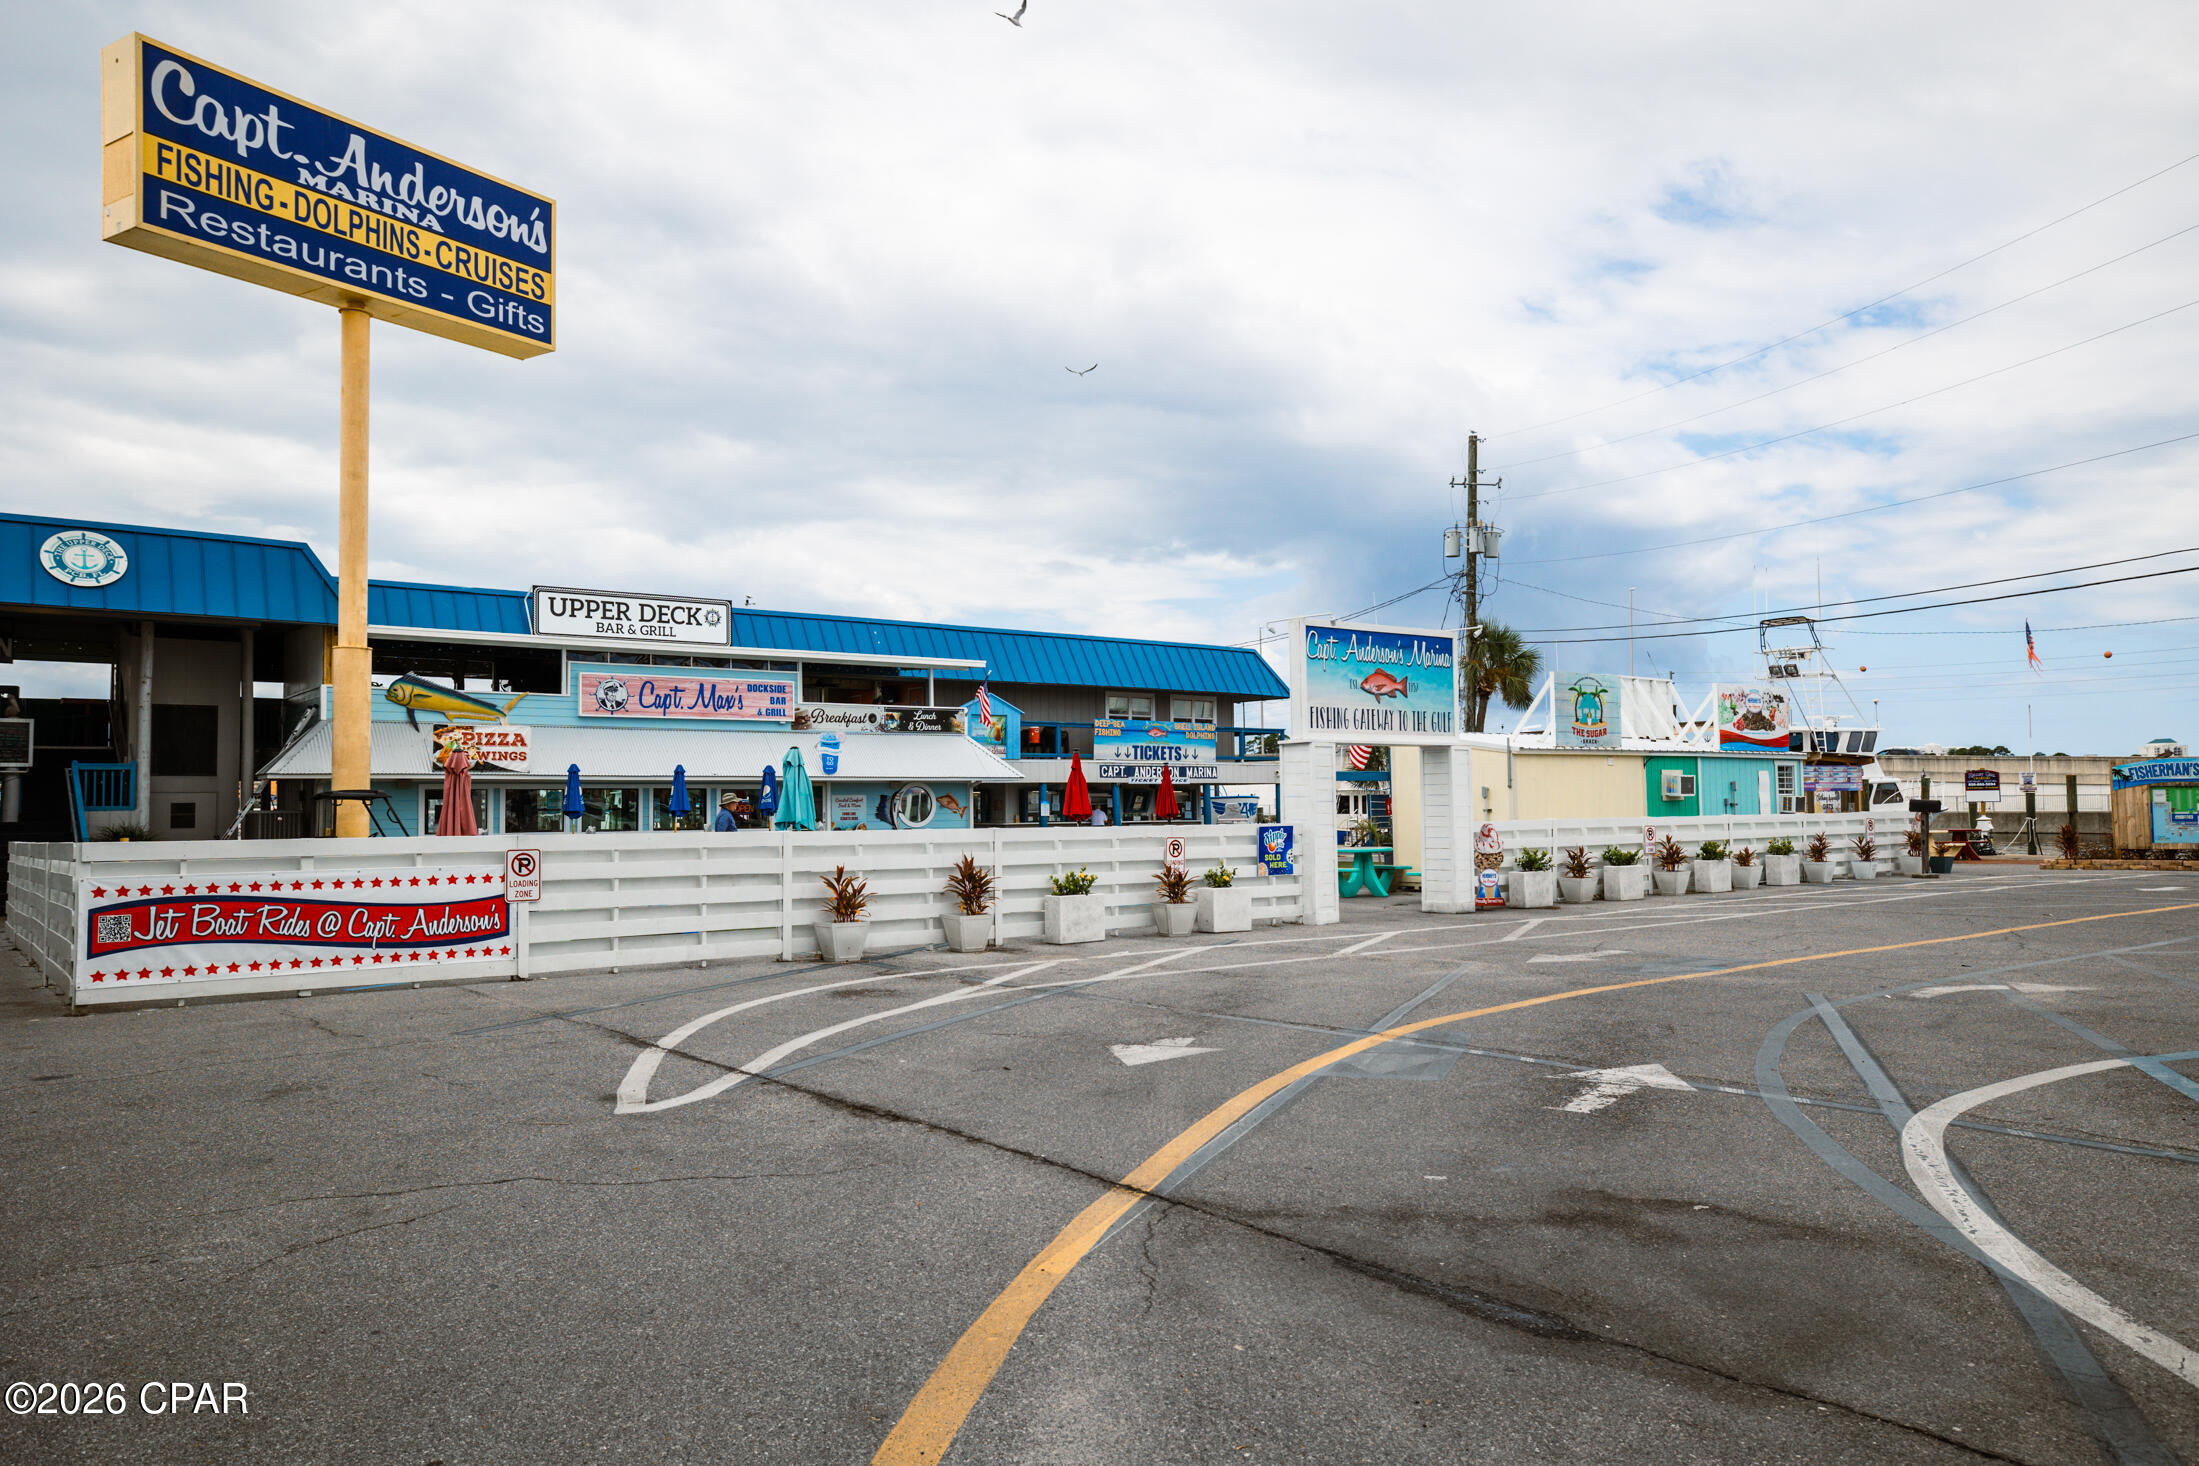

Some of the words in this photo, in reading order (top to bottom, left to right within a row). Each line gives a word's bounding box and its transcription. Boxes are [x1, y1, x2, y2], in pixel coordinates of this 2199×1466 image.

[151, 59, 309, 164] Capt.
[315, 133, 548, 254] Anderson's
[297, 167, 445, 233] MARINA
[160, 189, 428, 299] Restaurants
[467, 290, 545, 335] Gifts
[66, 538, 98, 547] UPPER
[97, 544, 114, 560] DECK
[548, 596, 632, 622] UPPER
[638, 603, 703, 626] DECK
[596, 622, 625, 635] BAR
[628, 624, 637, 635] &
[640, 625, 677, 638] GRILL
[1306, 630, 1338, 672] Capt.
[1341, 633, 1404, 666] Anderson's
[1406, 640, 1452, 670] Marina
[747, 684, 786, 694] DOCKSIDE
[638, 680, 684, 716] Capt.
[684, 683, 744, 712] Max's
[770, 696, 786, 705] BAR
[757, 708, 762, 716] &
[766, 708, 786, 716] GRILL
[810, 708, 868, 728] Breakfast
[913, 710, 936, 720] Lunch
[1310, 706, 1350, 730] FISHING
[1354, 708, 1394, 731] GATEWAY
[1398, 710, 1408, 732] TO
[1412, 710, 1428, 732] THE
[1431, 711, 1452, 733] GULF
[908, 722, 914, 730] &
[916, 720, 942, 730] Dinner
[1094, 720, 1126, 728] DEEP-SEA
[1194, 724, 1216, 732] ISLAND
[462, 732, 528, 747] PIZZA
[1094, 728, 1122, 736] FISHING
[1572, 726, 1585, 738] THE
[1586, 727, 1608, 738] SUGAR
[476, 752, 528, 761] WINGS
[1132, 744, 1182, 761] TICKETS
[1101, 766, 1127, 777] CAPT.
[1134, 766, 1180, 778] ANDERON
[1186, 767, 1218, 778] MARINA
[2128, 762, 2199, 781] FISHERMAN'S
[509, 880, 538, 888] LOADING
[514, 890, 533, 898] ZONE
[133, 905, 186, 940] Jet
[190, 903, 254, 936] Boat
[256, 904, 310, 938] Rides
[316, 910, 342, 938] @
[347, 908, 401, 950] Capt.
[400, 904, 501, 940] Anderson's
